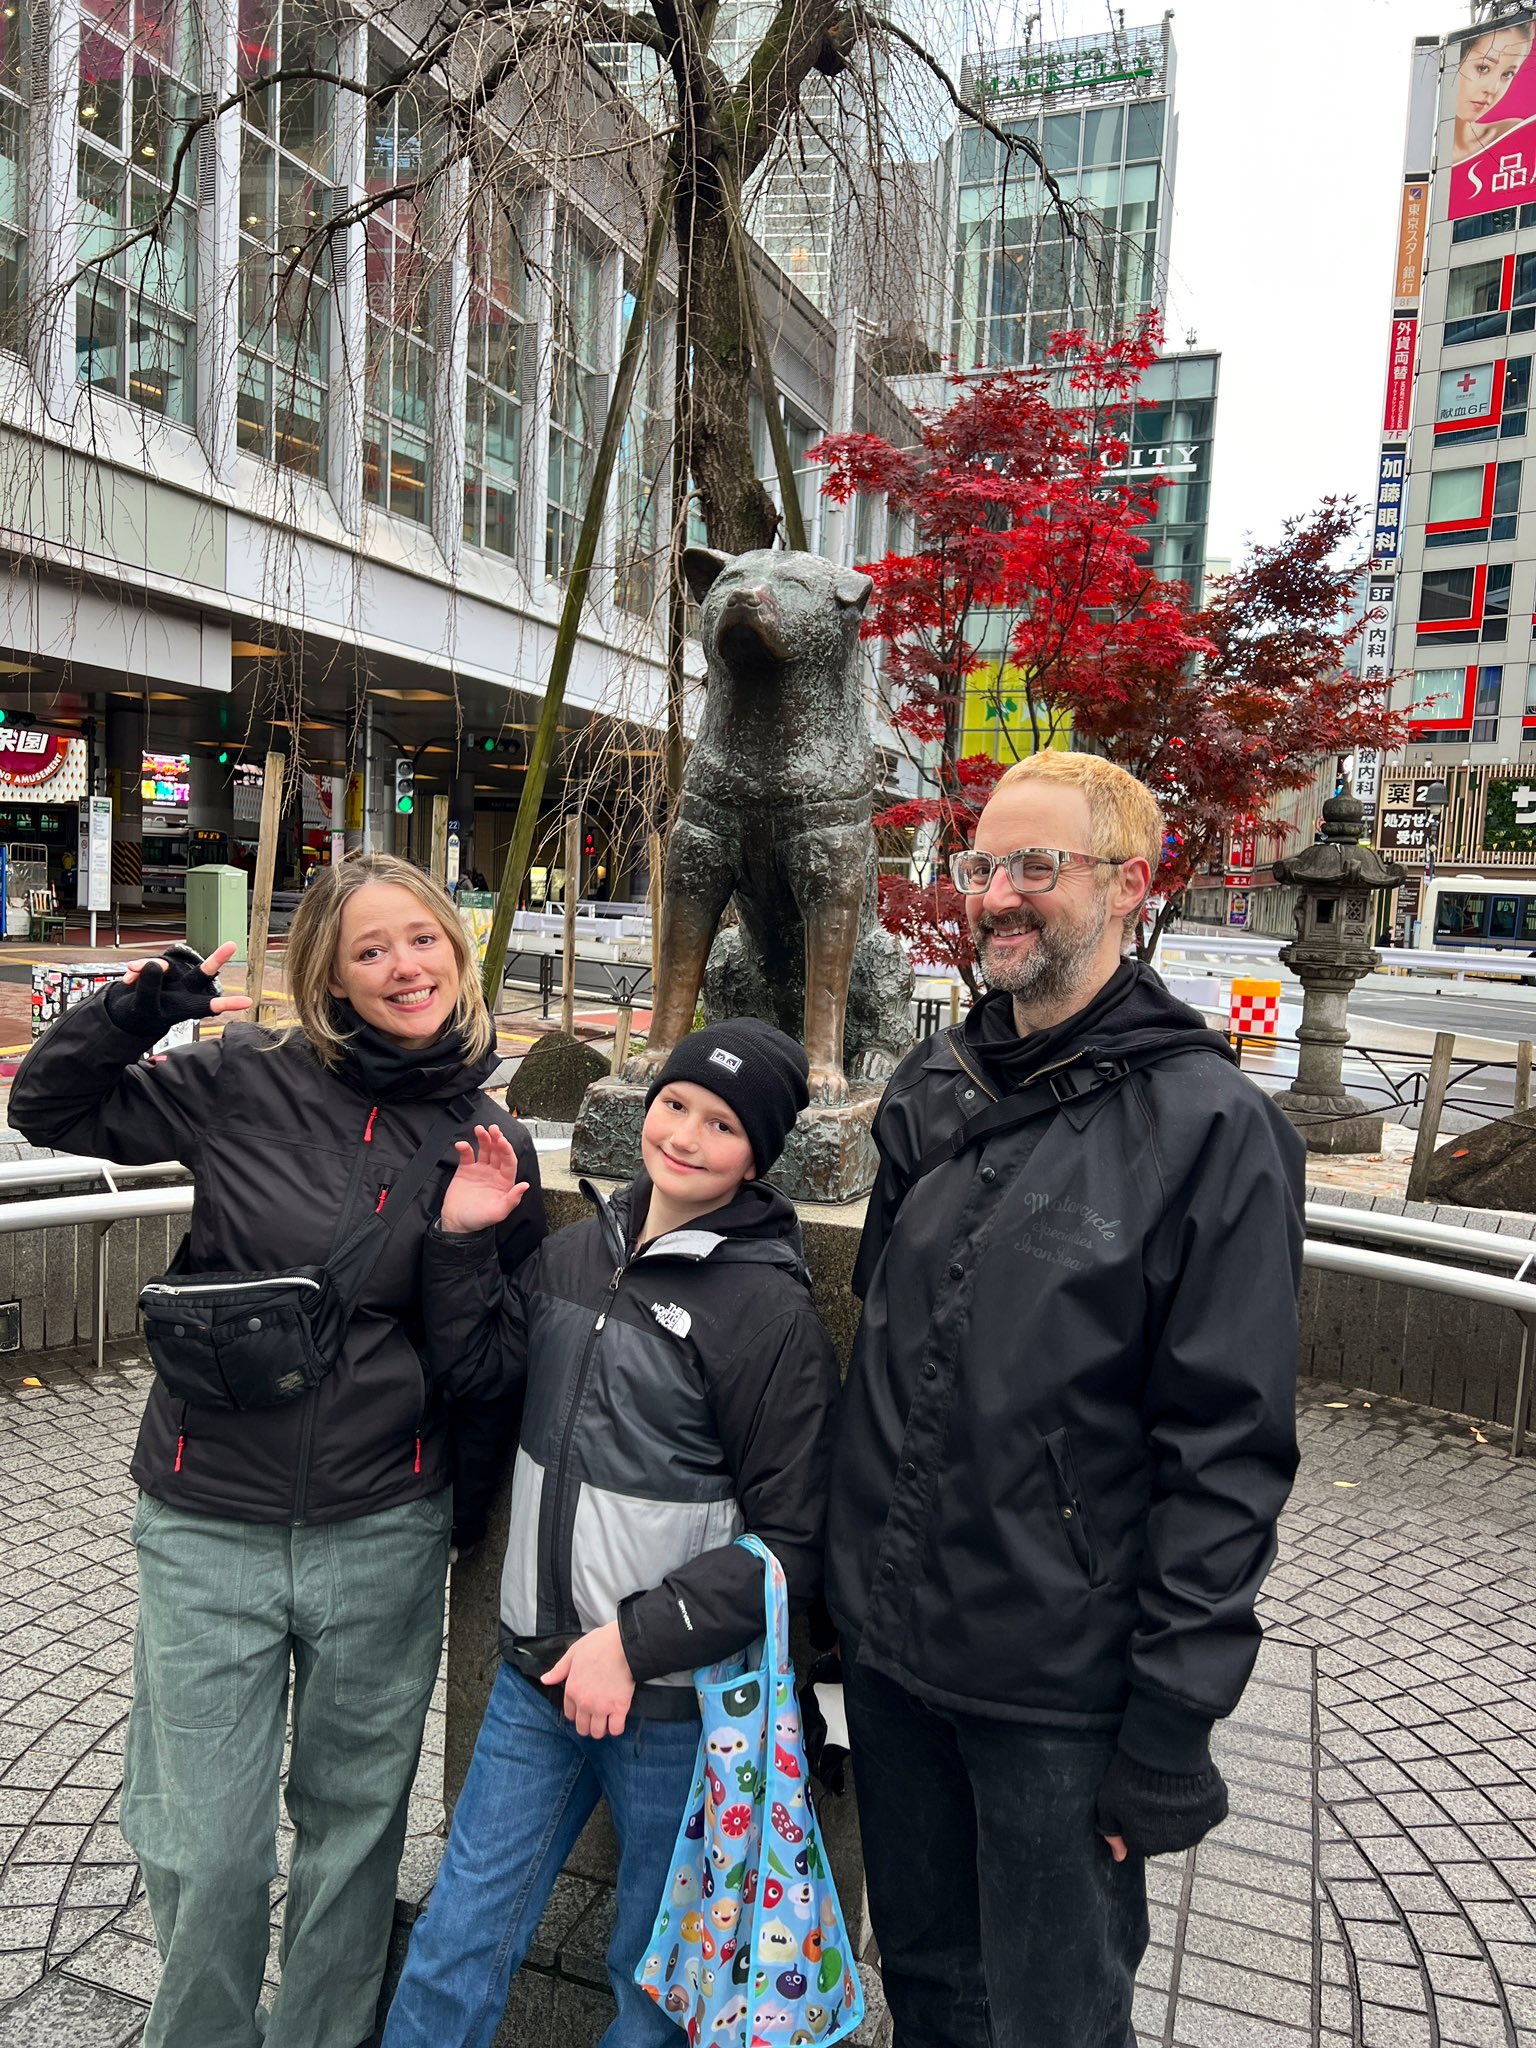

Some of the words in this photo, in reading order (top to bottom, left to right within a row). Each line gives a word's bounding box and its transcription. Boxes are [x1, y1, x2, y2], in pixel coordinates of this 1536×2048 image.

[1073, 55, 1150, 79] CITY
[1401, 203, 1421, 294] 東京スター銀行
[1393, 321, 1412, 381] 外貨両替
[1440, 402, 1488, 419] 献血6F
[1388, 430, 1403, 440] 7F
[1375, 458, 1403, 552] 加藤眼科
[1371, 588, 1392, 601] 3F
[1367, 628, 1387, 658] 内科
[14, 752, 63, 784] AMUSEMENT
[1356, 749, 1377, 796] 療内科
[1387, 783, 1411, 804] 薬
[448, 820, 458, 830] 22
[1383, 812, 1440, 828] 処方せん
[1396, 829, 1425, 845] 受付
[650, 1302, 681, 1323] NORTH
[669, 1302, 684, 1315] THE
[655, 1313, 675, 1330] FACE
